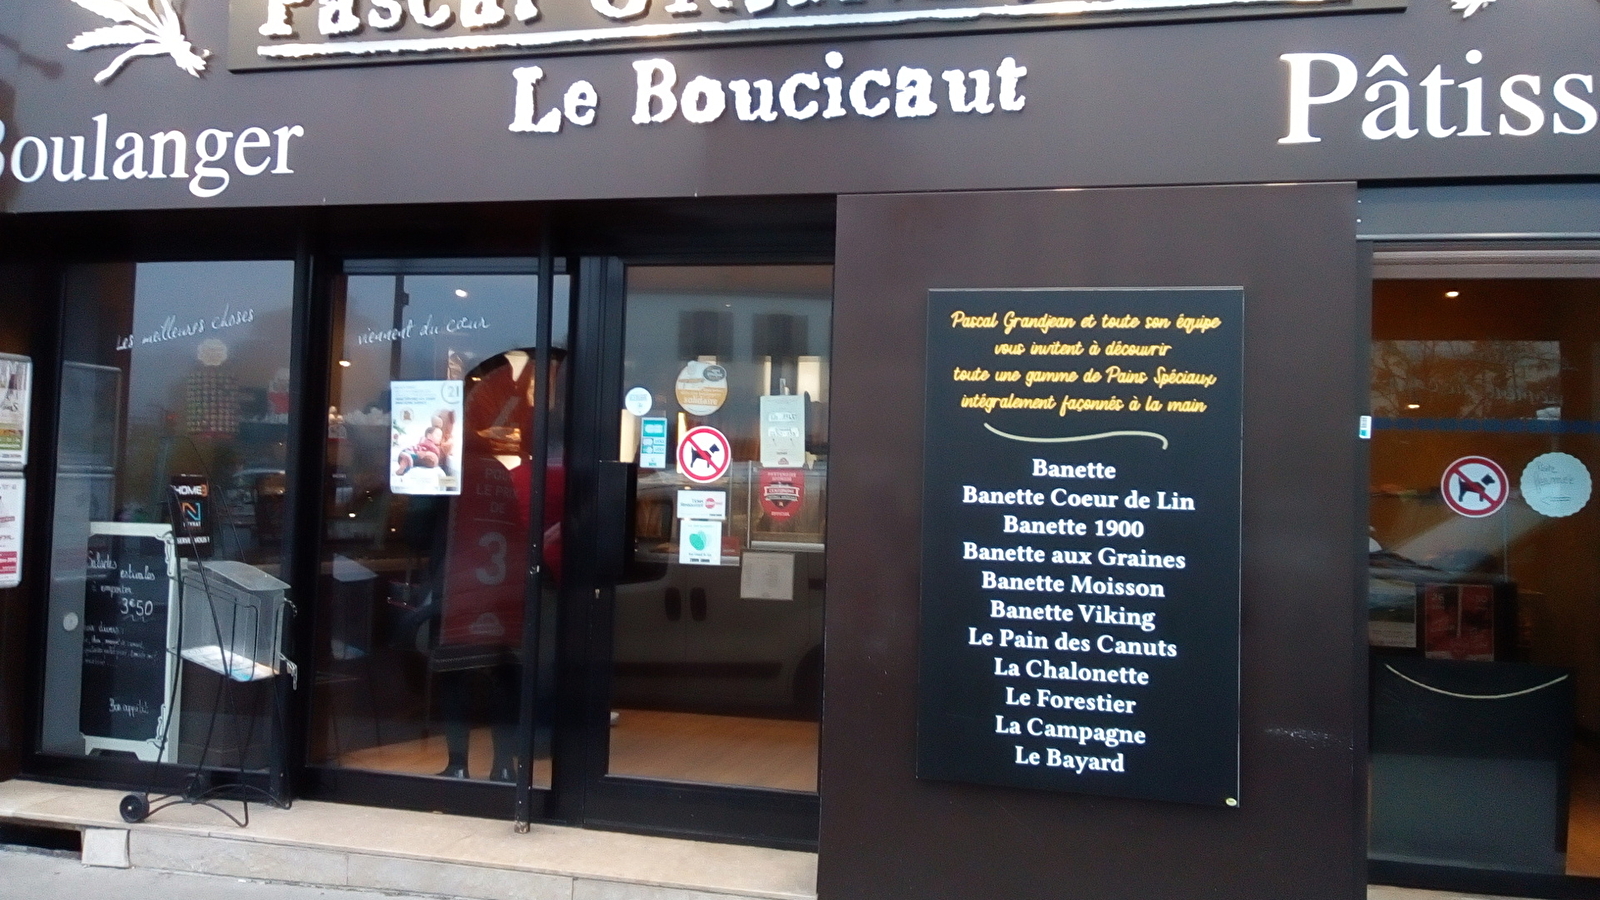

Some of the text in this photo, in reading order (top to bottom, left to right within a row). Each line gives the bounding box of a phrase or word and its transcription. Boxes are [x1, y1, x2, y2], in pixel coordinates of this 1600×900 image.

[508, 51, 1028, 133] Le Boucicaut
[1278, 50, 1598, 144] Pâtiss
[0, 114, 304, 198] oulanger
[116, 303, 255, 351] Les meilleures choses
[358, 319, 416, 346] viennent
[420, 314, 439, 337] du
[951, 311, 1223, 335] Pascal Grandjean et toute son équipe
[994, 339, 1173, 357] vous invitent à découvrir
[953, 365, 1218, 389] toute une gamme de Pains Spéciaux
[961, 392, 1208, 418] intégralement façonnés à la main
[1032, 458, 1117, 480] Banette
[962, 485, 1196, 511] Banette Coeur de Lin
[1003, 515, 1145, 539] Banette 1900
[962, 542, 1186, 570] Banette aux Graines
[981, 571, 1166, 598] Banette Moisson
[990, 600, 1157, 632] Banette Viking
[968, 627, 1178, 658] Le Pain des Canuts
[994, 657, 1150, 686] La Chalonette
[1005, 687, 1137, 714] Le Forestier
[995, 715, 1147, 748] La Campagne
[1015, 746, 1125, 775] Le Bayard
